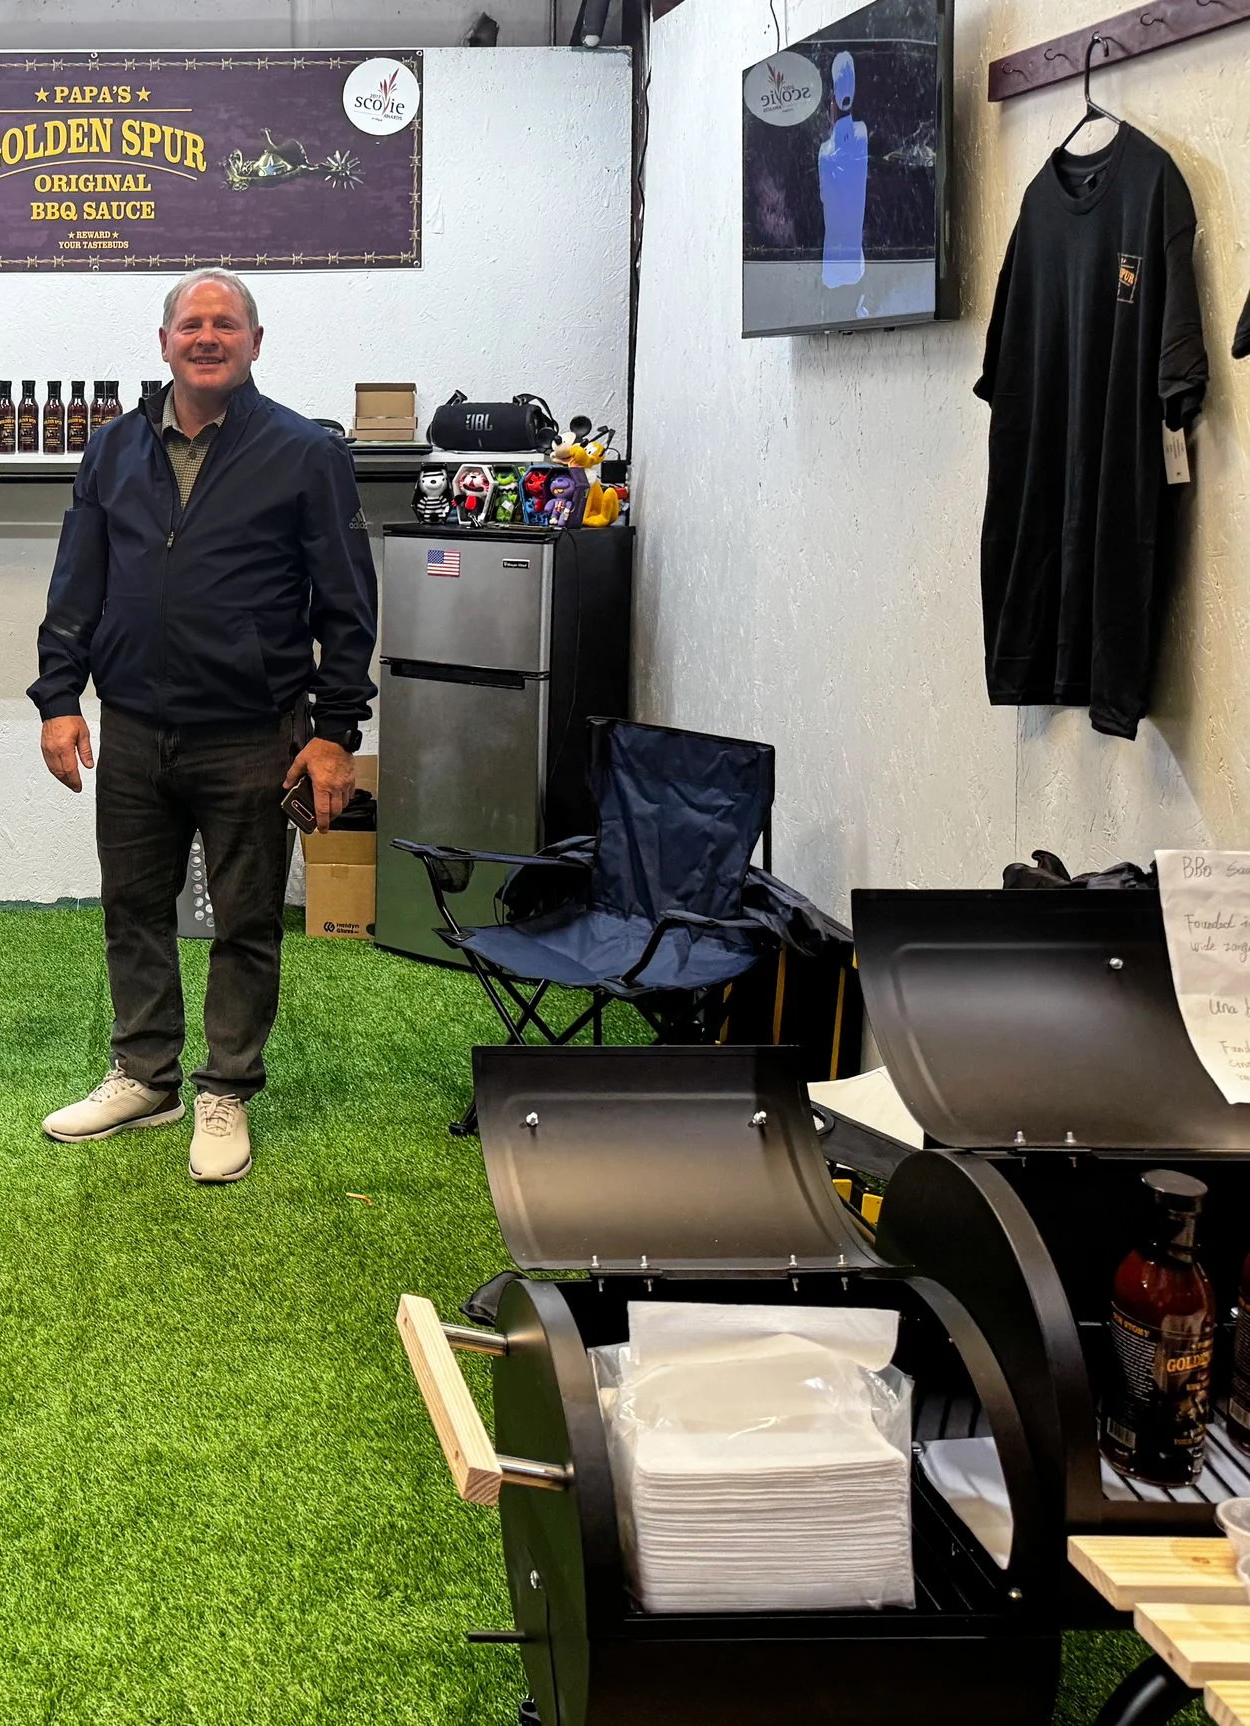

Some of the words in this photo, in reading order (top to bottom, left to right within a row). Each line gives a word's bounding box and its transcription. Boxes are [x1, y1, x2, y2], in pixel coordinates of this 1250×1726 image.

[54, 86, 131, 103] PAPA'S
[122, 119, 207, 172] SPUR
[35, 174, 151, 192] ORIGINAL
[31, 202, 78, 220] BBQ
[83, 201, 155, 220] SAUCE
[76, 231, 111, 239] REWARD
[59, 241, 81, 249] YOUR
[83, 241, 129, 249] TASTEBUDS
[465, 413, 494, 431] JBL
